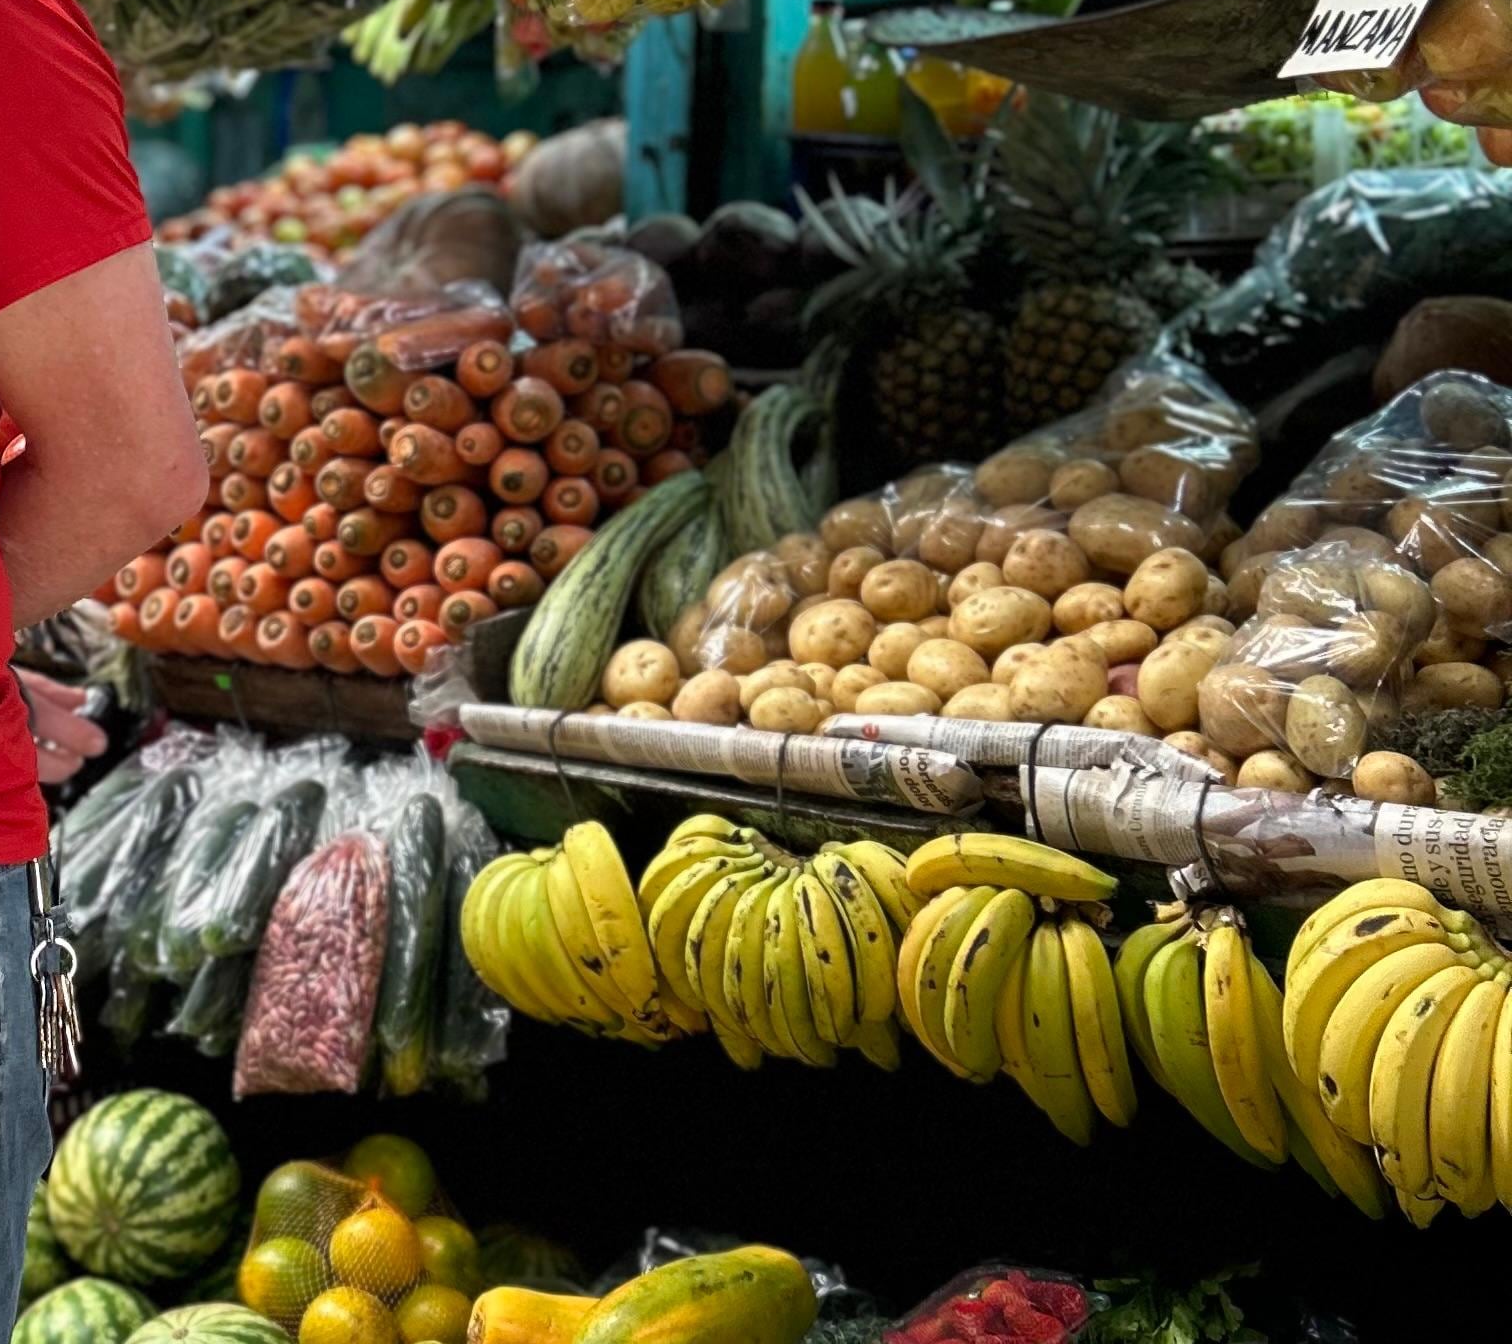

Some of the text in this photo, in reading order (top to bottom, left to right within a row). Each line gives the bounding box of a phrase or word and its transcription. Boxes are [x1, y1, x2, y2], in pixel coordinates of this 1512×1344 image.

[1301, 3, 1417, 59] MANZANA
[1426, 817, 1443, 856] sus
[1448, 817, 1486, 912] seguridad
